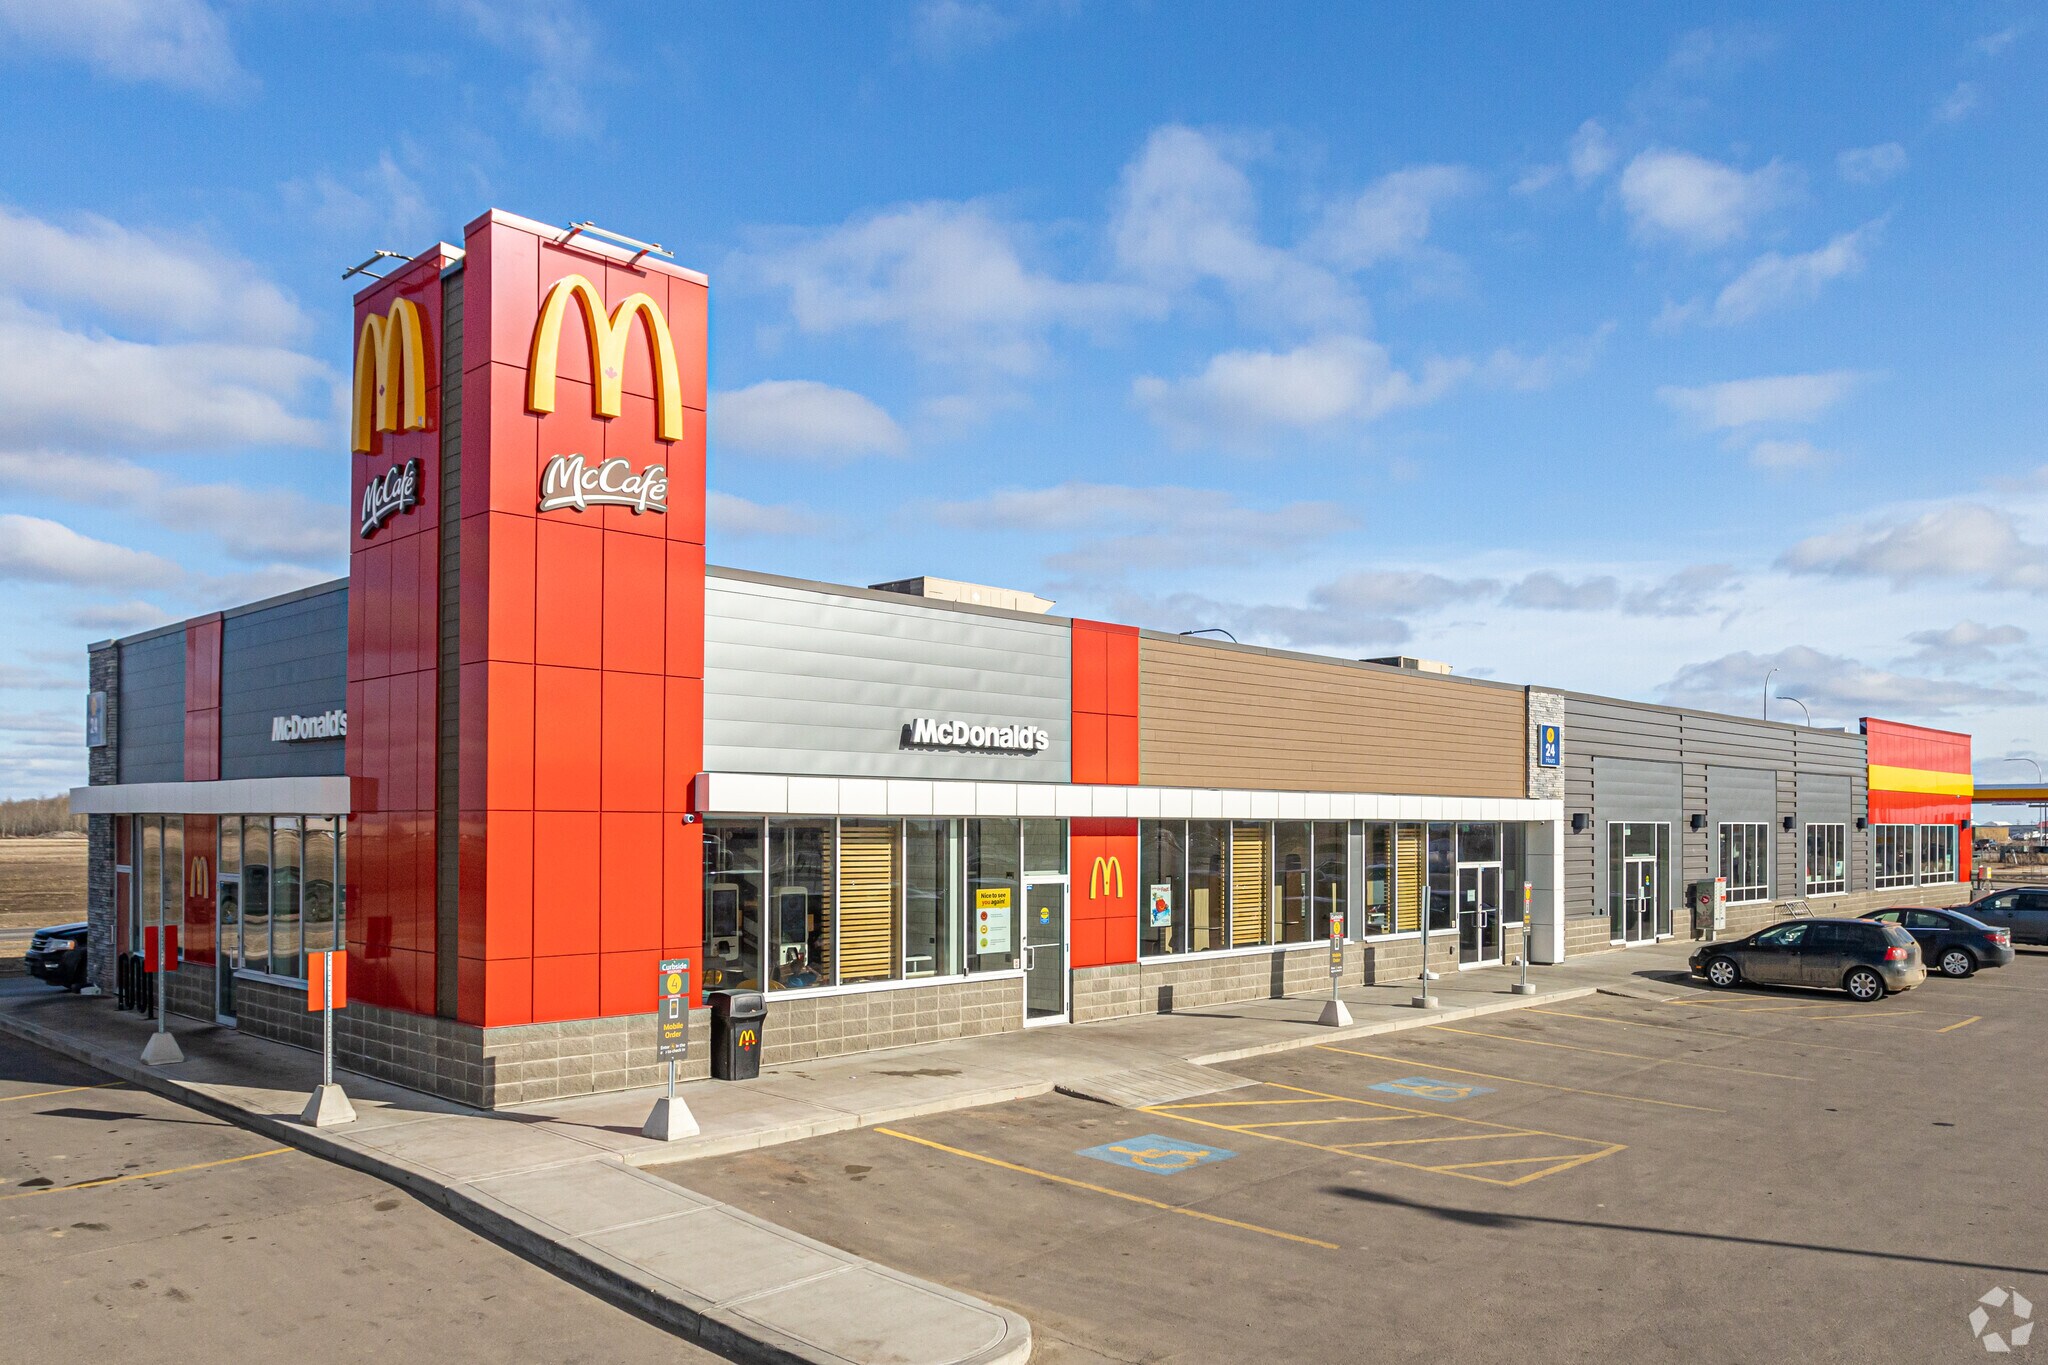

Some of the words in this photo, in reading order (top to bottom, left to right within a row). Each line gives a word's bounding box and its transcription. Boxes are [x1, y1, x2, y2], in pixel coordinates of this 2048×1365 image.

[361, 459, 415, 530] McCafé
[546, 456, 667, 511] McCafé
[271, 709, 347, 741] McDonald's
[911, 717, 1050, 750] McDonald's
[1545, 743, 1556, 757] 24
[671, 978, 678, 989] 4
